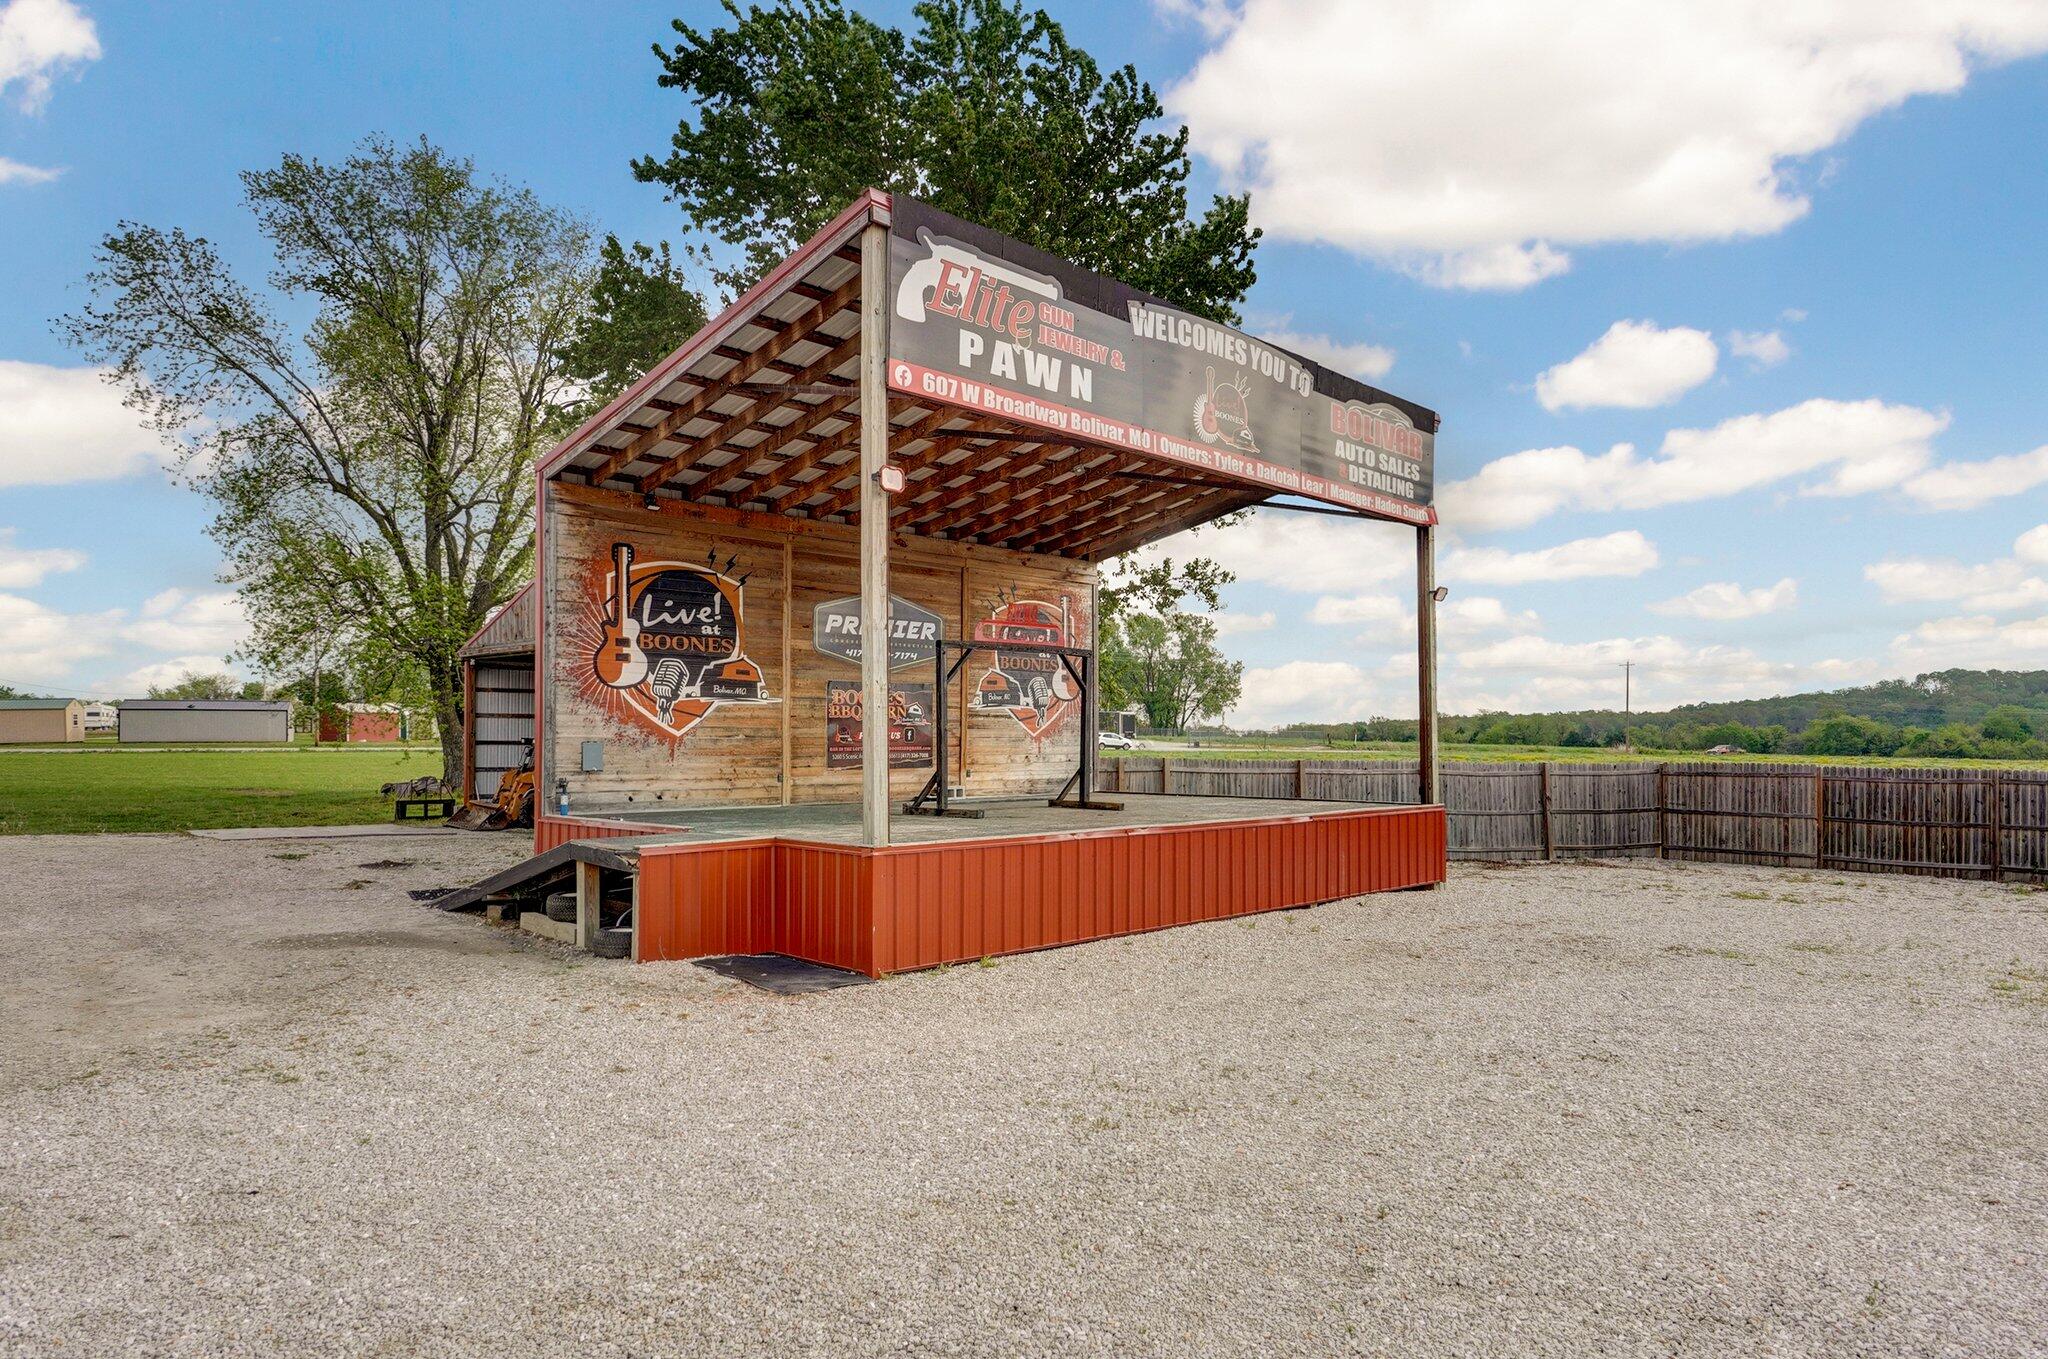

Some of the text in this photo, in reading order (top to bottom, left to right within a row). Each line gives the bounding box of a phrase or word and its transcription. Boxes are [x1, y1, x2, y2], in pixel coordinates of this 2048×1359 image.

[925, 259, 1035, 338] Elite
[1039, 302, 1074, 332] GUN
[959, 328, 1093, 403] PAWN
[1038, 326, 1126, 372] JEWELRY &
[1130, 306, 1314, 398] WELCOMES YOU TO
[1215, 410, 1245, 425] BOONES
[1331, 402, 1423, 461] BOLIVAR
[922, 372, 958, 398] 607
[961, 382, 980, 405] W
[984, 389, 1068, 429] Broadway
[1071, 412, 1126, 444] Bolivar,
[1129, 428, 1151, 449] MO
[1160, 437, 1211, 465] Owners:
[1214, 451, 1243, 472] Tyler
[1246, 462, 1255, 476] &
[1301, 473, 1323, 495] Lear
[1330, 483, 1374, 509] Manager:
[1375, 496, 1401, 516] Haden
[1403, 504, 1428, 522] Smith
[1335, 439, 1420, 481] AUTO SALES
[1349, 464, 1414, 499] DETAILING
[642, 592, 722, 627] Live!
[825, 614, 936, 640] PRIER
[639, 633, 734, 653] BOONES
[700, 625, 721, 636] at
[1000, 656, 1058, 672] BOONES
[829, 704, 863, 721] BBQ
